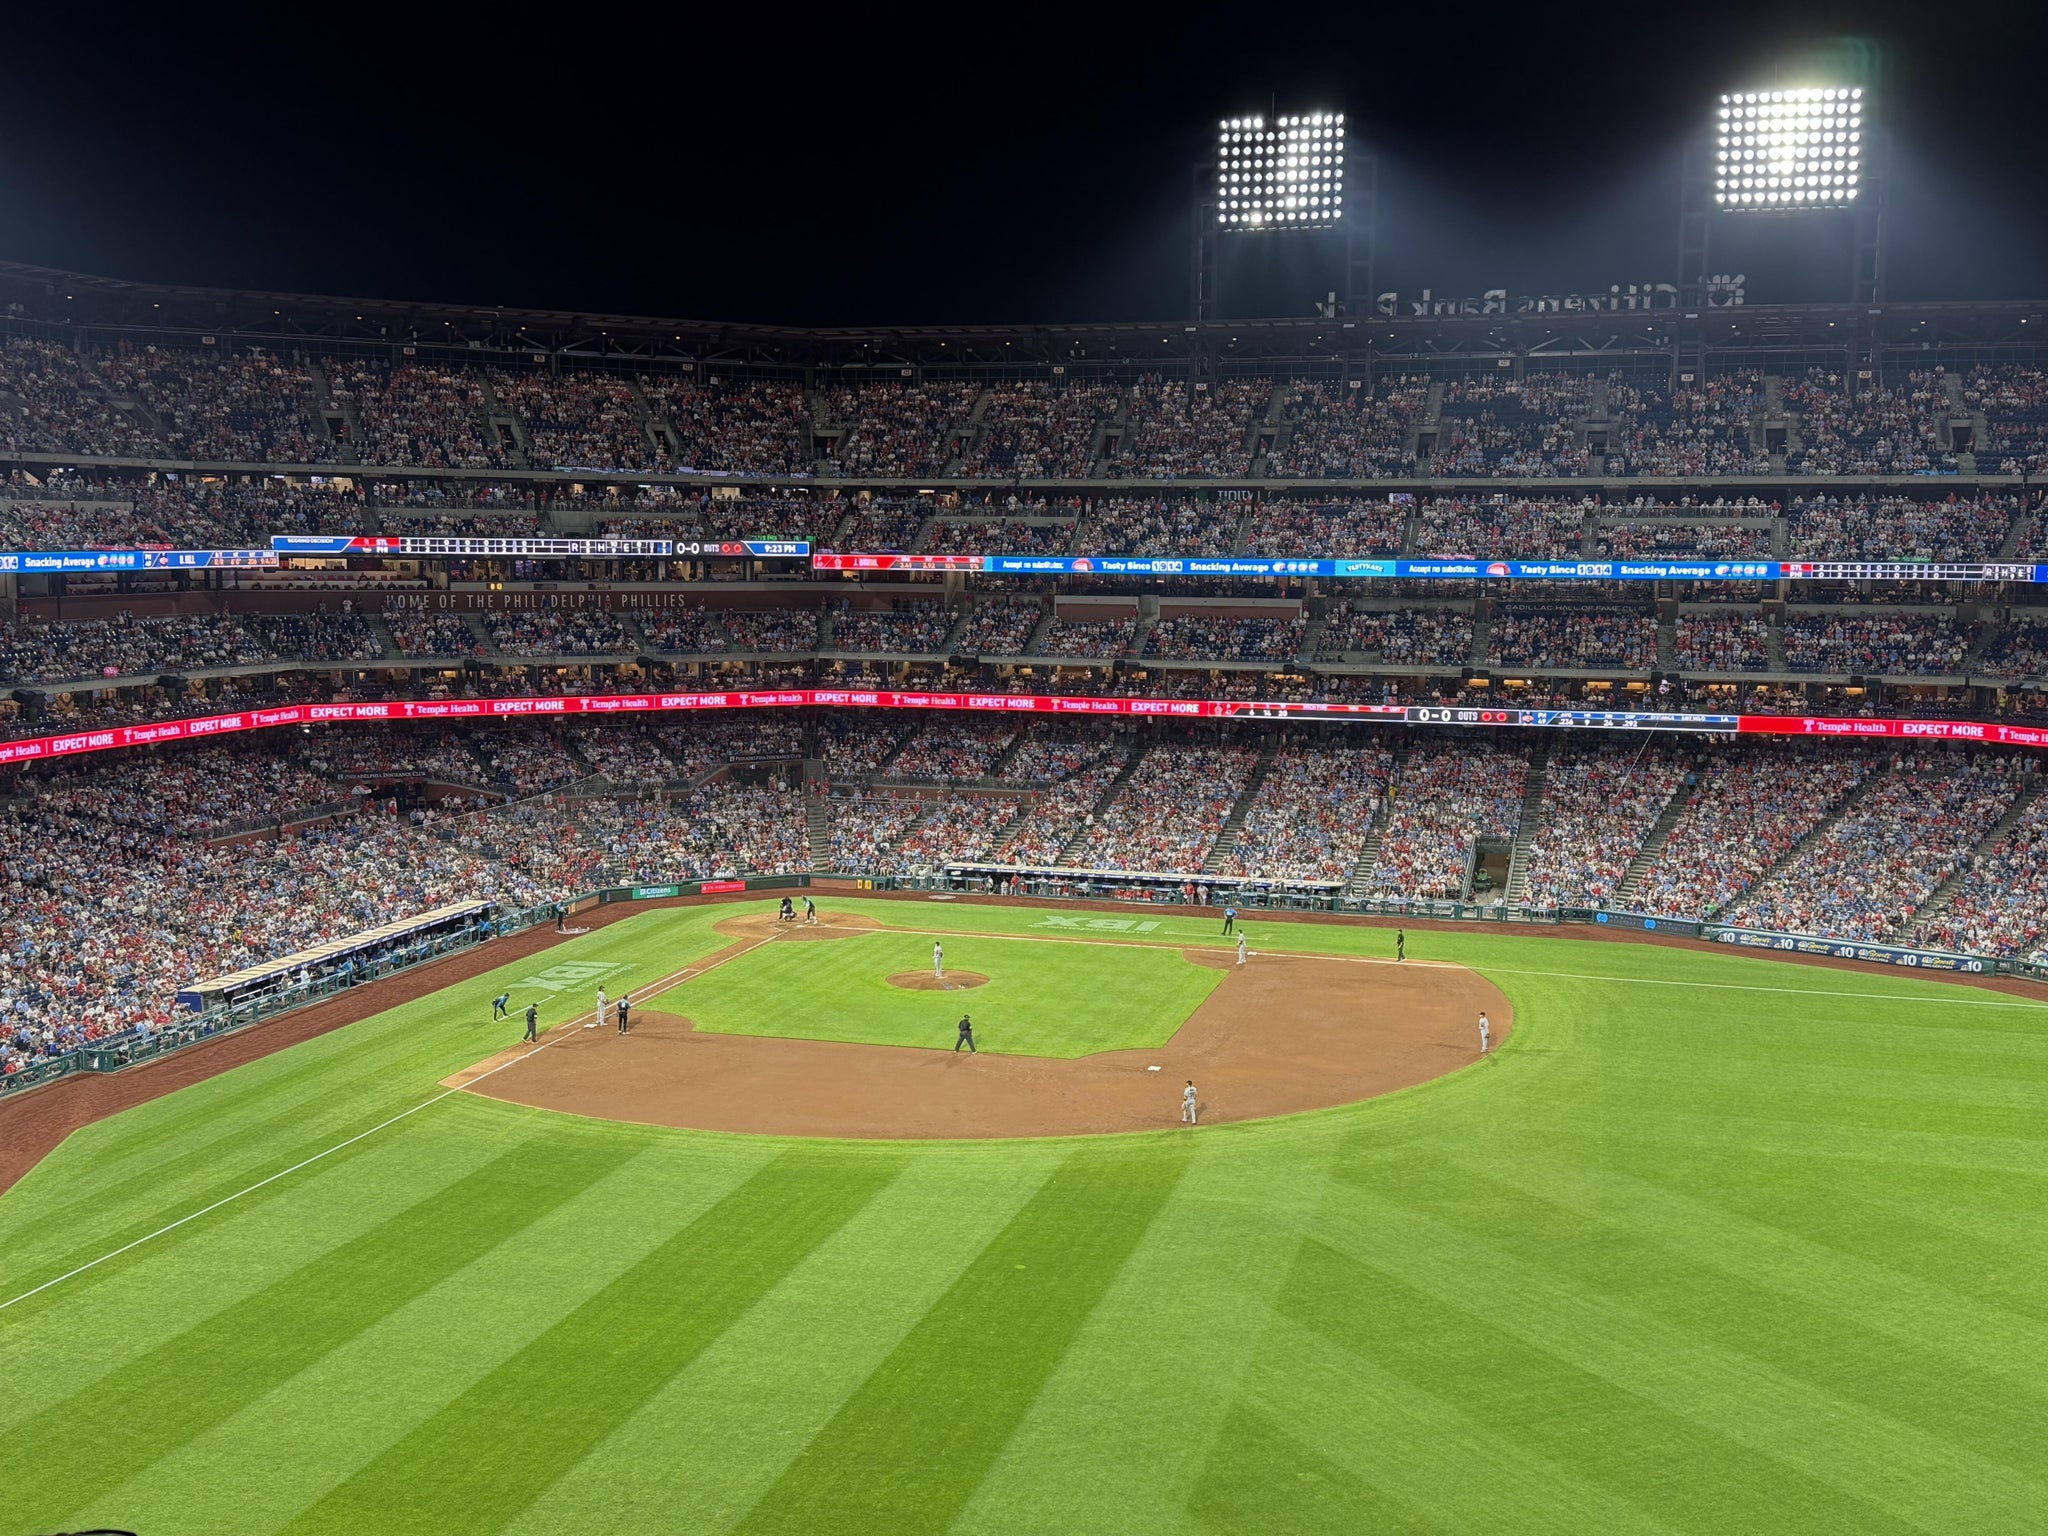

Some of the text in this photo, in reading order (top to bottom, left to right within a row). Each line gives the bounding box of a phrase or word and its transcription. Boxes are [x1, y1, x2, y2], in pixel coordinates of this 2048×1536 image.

[572, 543, 579, 551] R
[597, 543, 605, 552] H
[623, 543, 630, 552] E
[677, 543, 699, 554] 0-0
[704, 544, 719, 552] OUTS
[764, 545, 782, 553] 9:23
[25, 557, 95, 569] Snacking Average
[1102, 561, 1183, 571] Tasty Since 1914
[1190, 563, 1269, 573] Snacking Average
[1520, 564, 1612, 575] Tasty Since 1914
[1620, 566, 1710, 577] Snacking Average
[1987, 568, 1992, 576] R
[2019, 569, 2023, 577] E
[386, 594, 685, 608] HOME OF THE PHILLIES
[661, 696, 727, 706] EXPECT MORE
[750, 694, 802, 704] Temple Health
[815, 693, 878, 703] EXPECT MORE
[902, 697, 956, 705] Temple Health
[969, 698, 1035, 708] EXPECT MORE
[417, 704, 479, 714] Temple Health
[494, 701, 564, 711] EXPECT MORE
[592, 699, 648, 709] Temple Health
[1063, 701, 1118, 710] Temple Health
[1132, 702, 1199, 713] EXPECT MORE
[311, 706, 388, 717] EXPECT MORE
[1458, 712, 1478, 720] OUTS
[259, 711, 298, 723] Temple Health
[191, 717, 241, 733] EXPECT MORE
[1817, 722, 1886, 733] Temple Health
[133, 725, 181, 741] Temple Health
[1903, 724, 1984, 737] EXPECT MORE
[2010, 729, 2039, 742] Temple
[53, 734, 114, 752] EXPECT MORE
[16, 744, 41, 755] Health
[1723, 933, 1735, 943] 10
[1750, 935, 1772, 943] Sports
[1781, 939, 1794, 950] 10
[1808, 942, 1831, 950] Sports
[1841, 947, 1854, 958] 10
[1868, 950, 1892, 959] Sports
[1903, 955, 1917, 966] 10
[1931, 958, 1956, 966] Sports
[1968, 961, 1982, 972] 10
